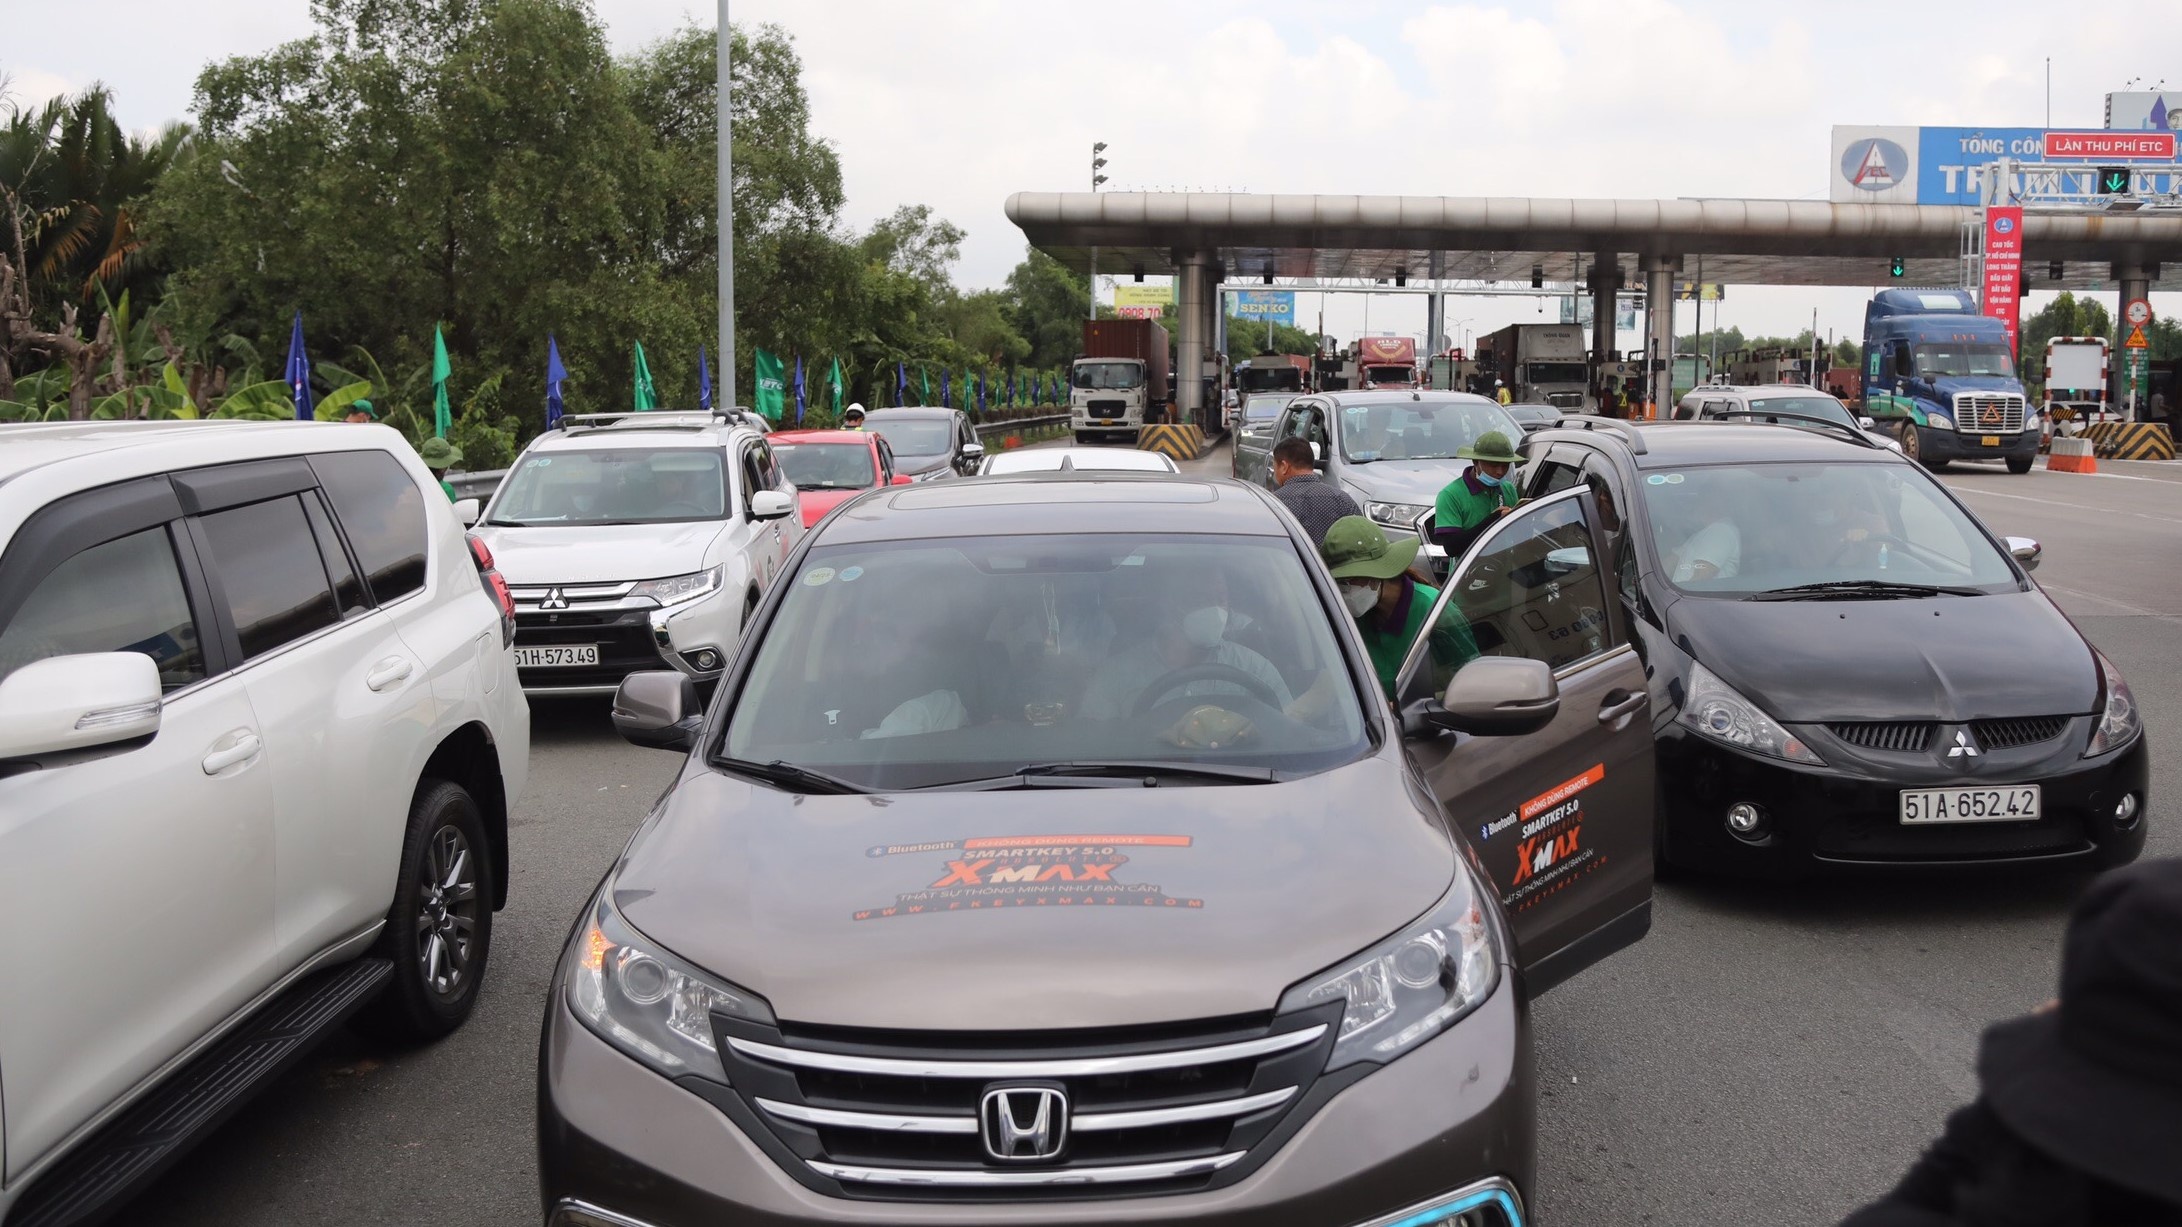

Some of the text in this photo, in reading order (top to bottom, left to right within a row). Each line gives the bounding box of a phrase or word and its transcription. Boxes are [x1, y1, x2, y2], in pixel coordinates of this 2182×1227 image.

[1959, 132, 2044, 154] TỔNG CÔN
[2055, 133, 2082, 151] LÀN
[2085, 142, 2111, 151] THU
[2115, 139, 2137, 152] PHÍ
[2140, 142, 2163, 152] ETC
[1240, 303, 1289, 313] SENKO
[514, 647, 596, 665] 51H-573.49
[1524, 777, 1590, 817] KHÔNG DÙNG REMOTE
[1904, 790, 2035, 819] 51A-652.42
[1488, 812, 1519, 836] Bluetooth
[1522, 799, 1580, 839] SMARTKEY 5.0
[887, 841, 955, 855] Bluetooth
[964, 847, 1115, 860] SMARTKEY 5.0
[1018, 885, 1056, 894] MINH
[1058, 884, 1093, 892] NHƯ
